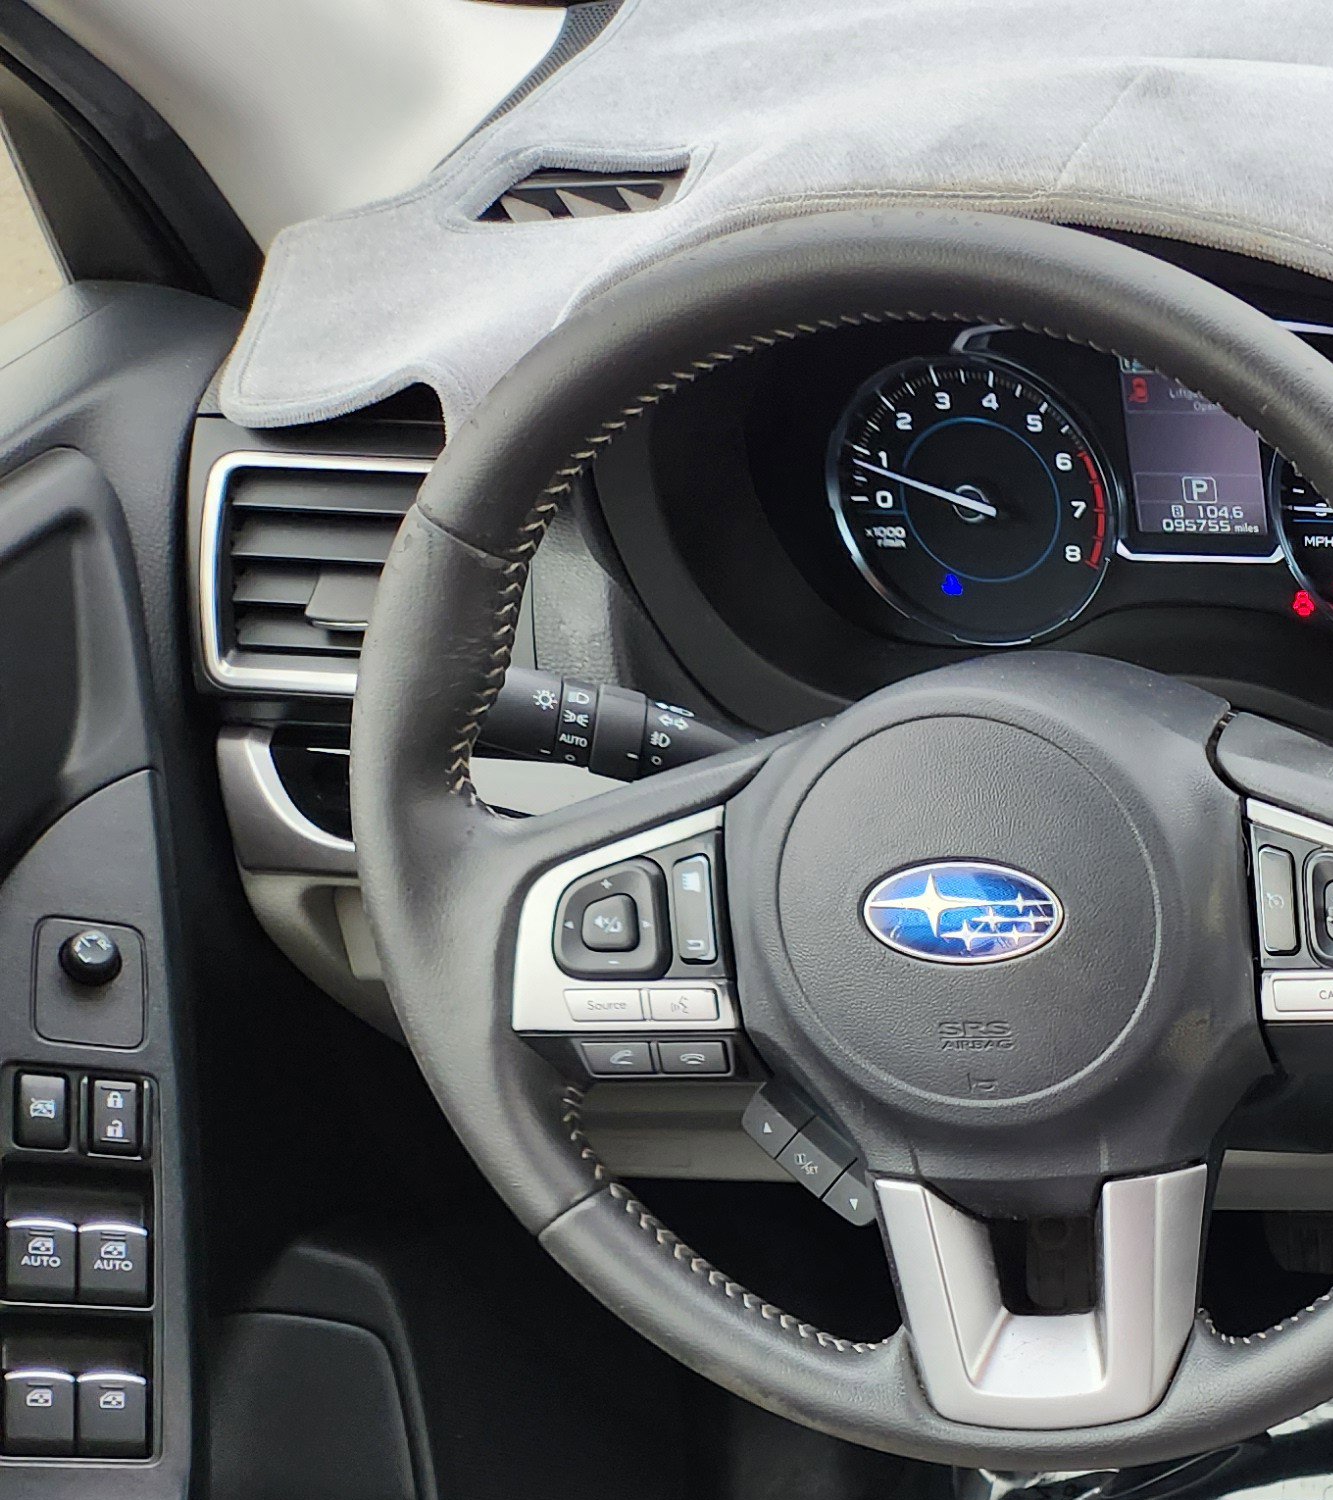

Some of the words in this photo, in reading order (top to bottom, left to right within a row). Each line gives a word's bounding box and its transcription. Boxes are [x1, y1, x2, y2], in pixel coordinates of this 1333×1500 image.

[934, 391, 951, 410] 3
[981, 393, 1000, 411] 4
[895, 412, 913, 431] 2
[1026, 414, 1044, 433] 5
[878, 451, 889, 469] 1
[1055, 452, 1073, 472] 6
[875, 490, 893, 509] 0
[1191, 480, 1208, 501] P
[1070, 501, 1086, 519] 7
[1199, 506, 1244, 520] 104.6
[1162, 519, 1231, 533] 095755
[1234, 524, 1260, 533] miles
[1065, 545, 1082, 563] 8
[559, 733, 588, 748] AUTO
[587, 1000, 627, 1010] Source
[939, 1021, 1012, 1038] SRS
[941, 1039, 1014, 1050] AIRBAG
[21, 1256, 61, 1268] AUTO
[94, 1260, 133, 1271] AUTO
